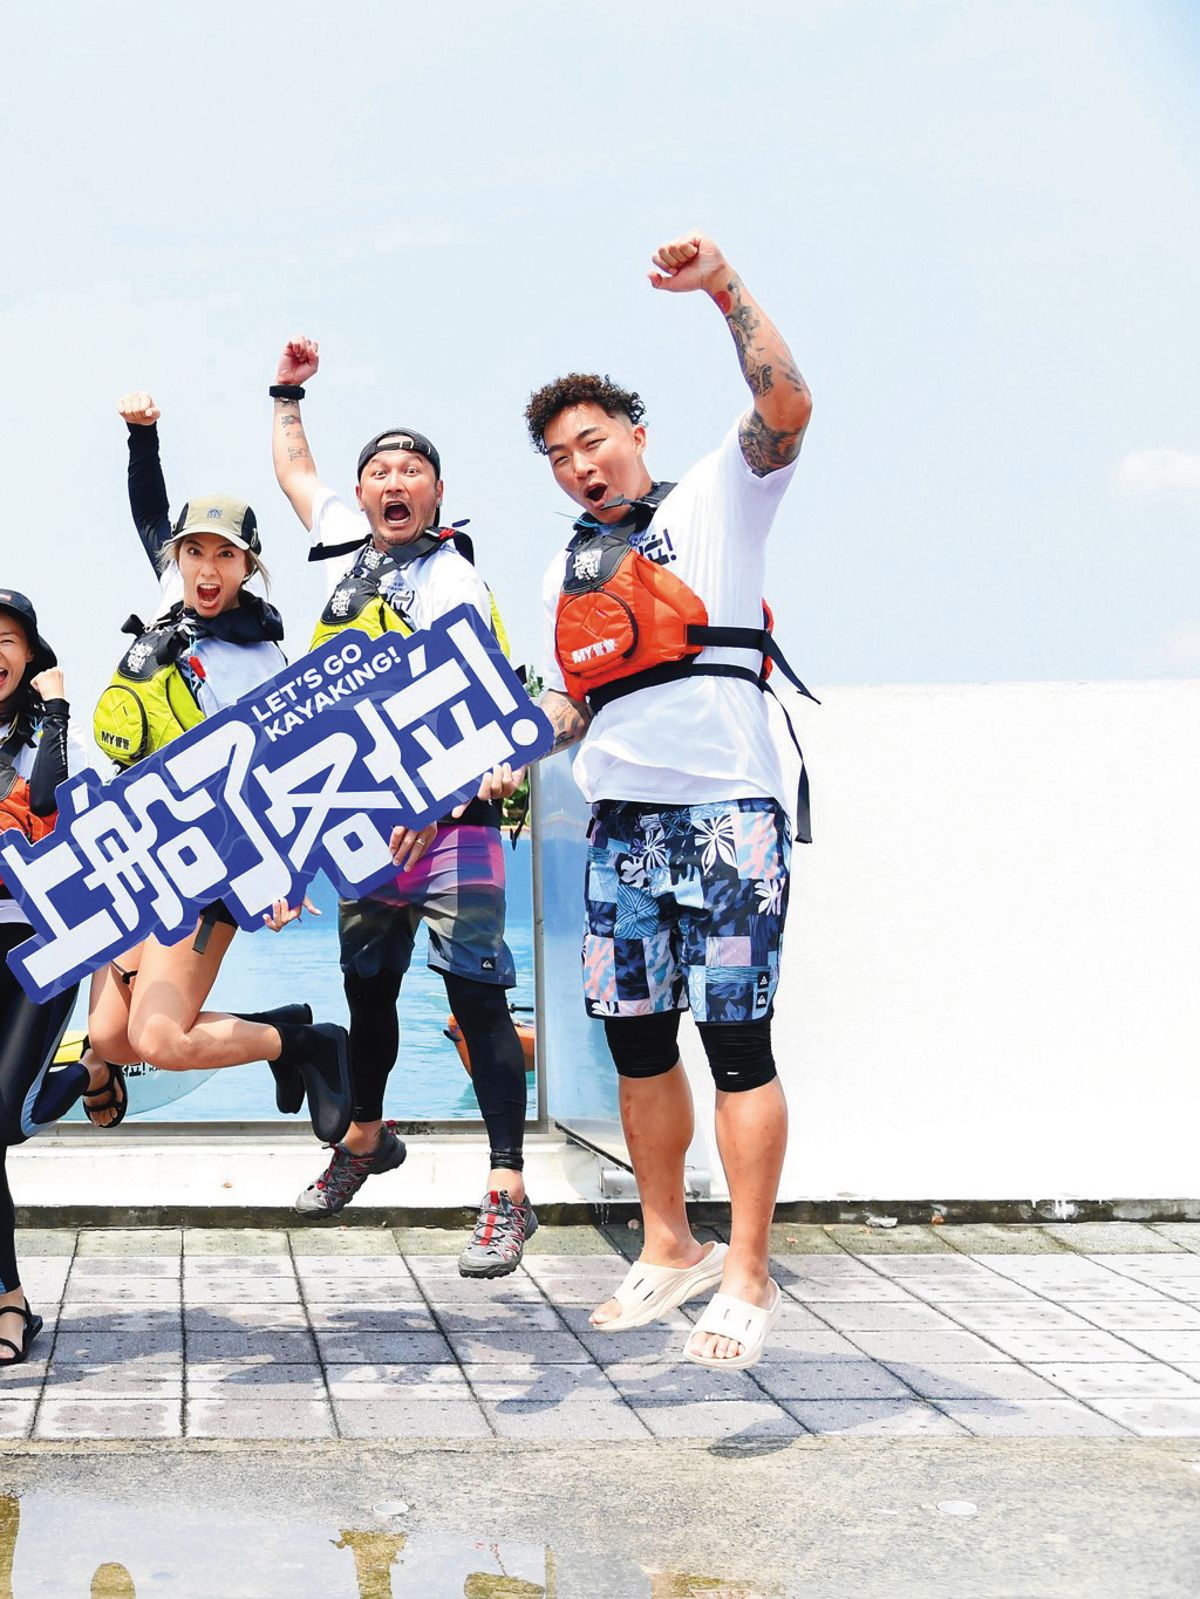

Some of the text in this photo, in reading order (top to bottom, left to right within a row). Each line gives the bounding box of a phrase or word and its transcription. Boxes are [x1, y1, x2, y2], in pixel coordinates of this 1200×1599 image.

[251, 643, 362, 722] LET'S GO
[264, 646, 402, 743] KAYAKING!
[0, 617, 540, 989] 上船了各位!
